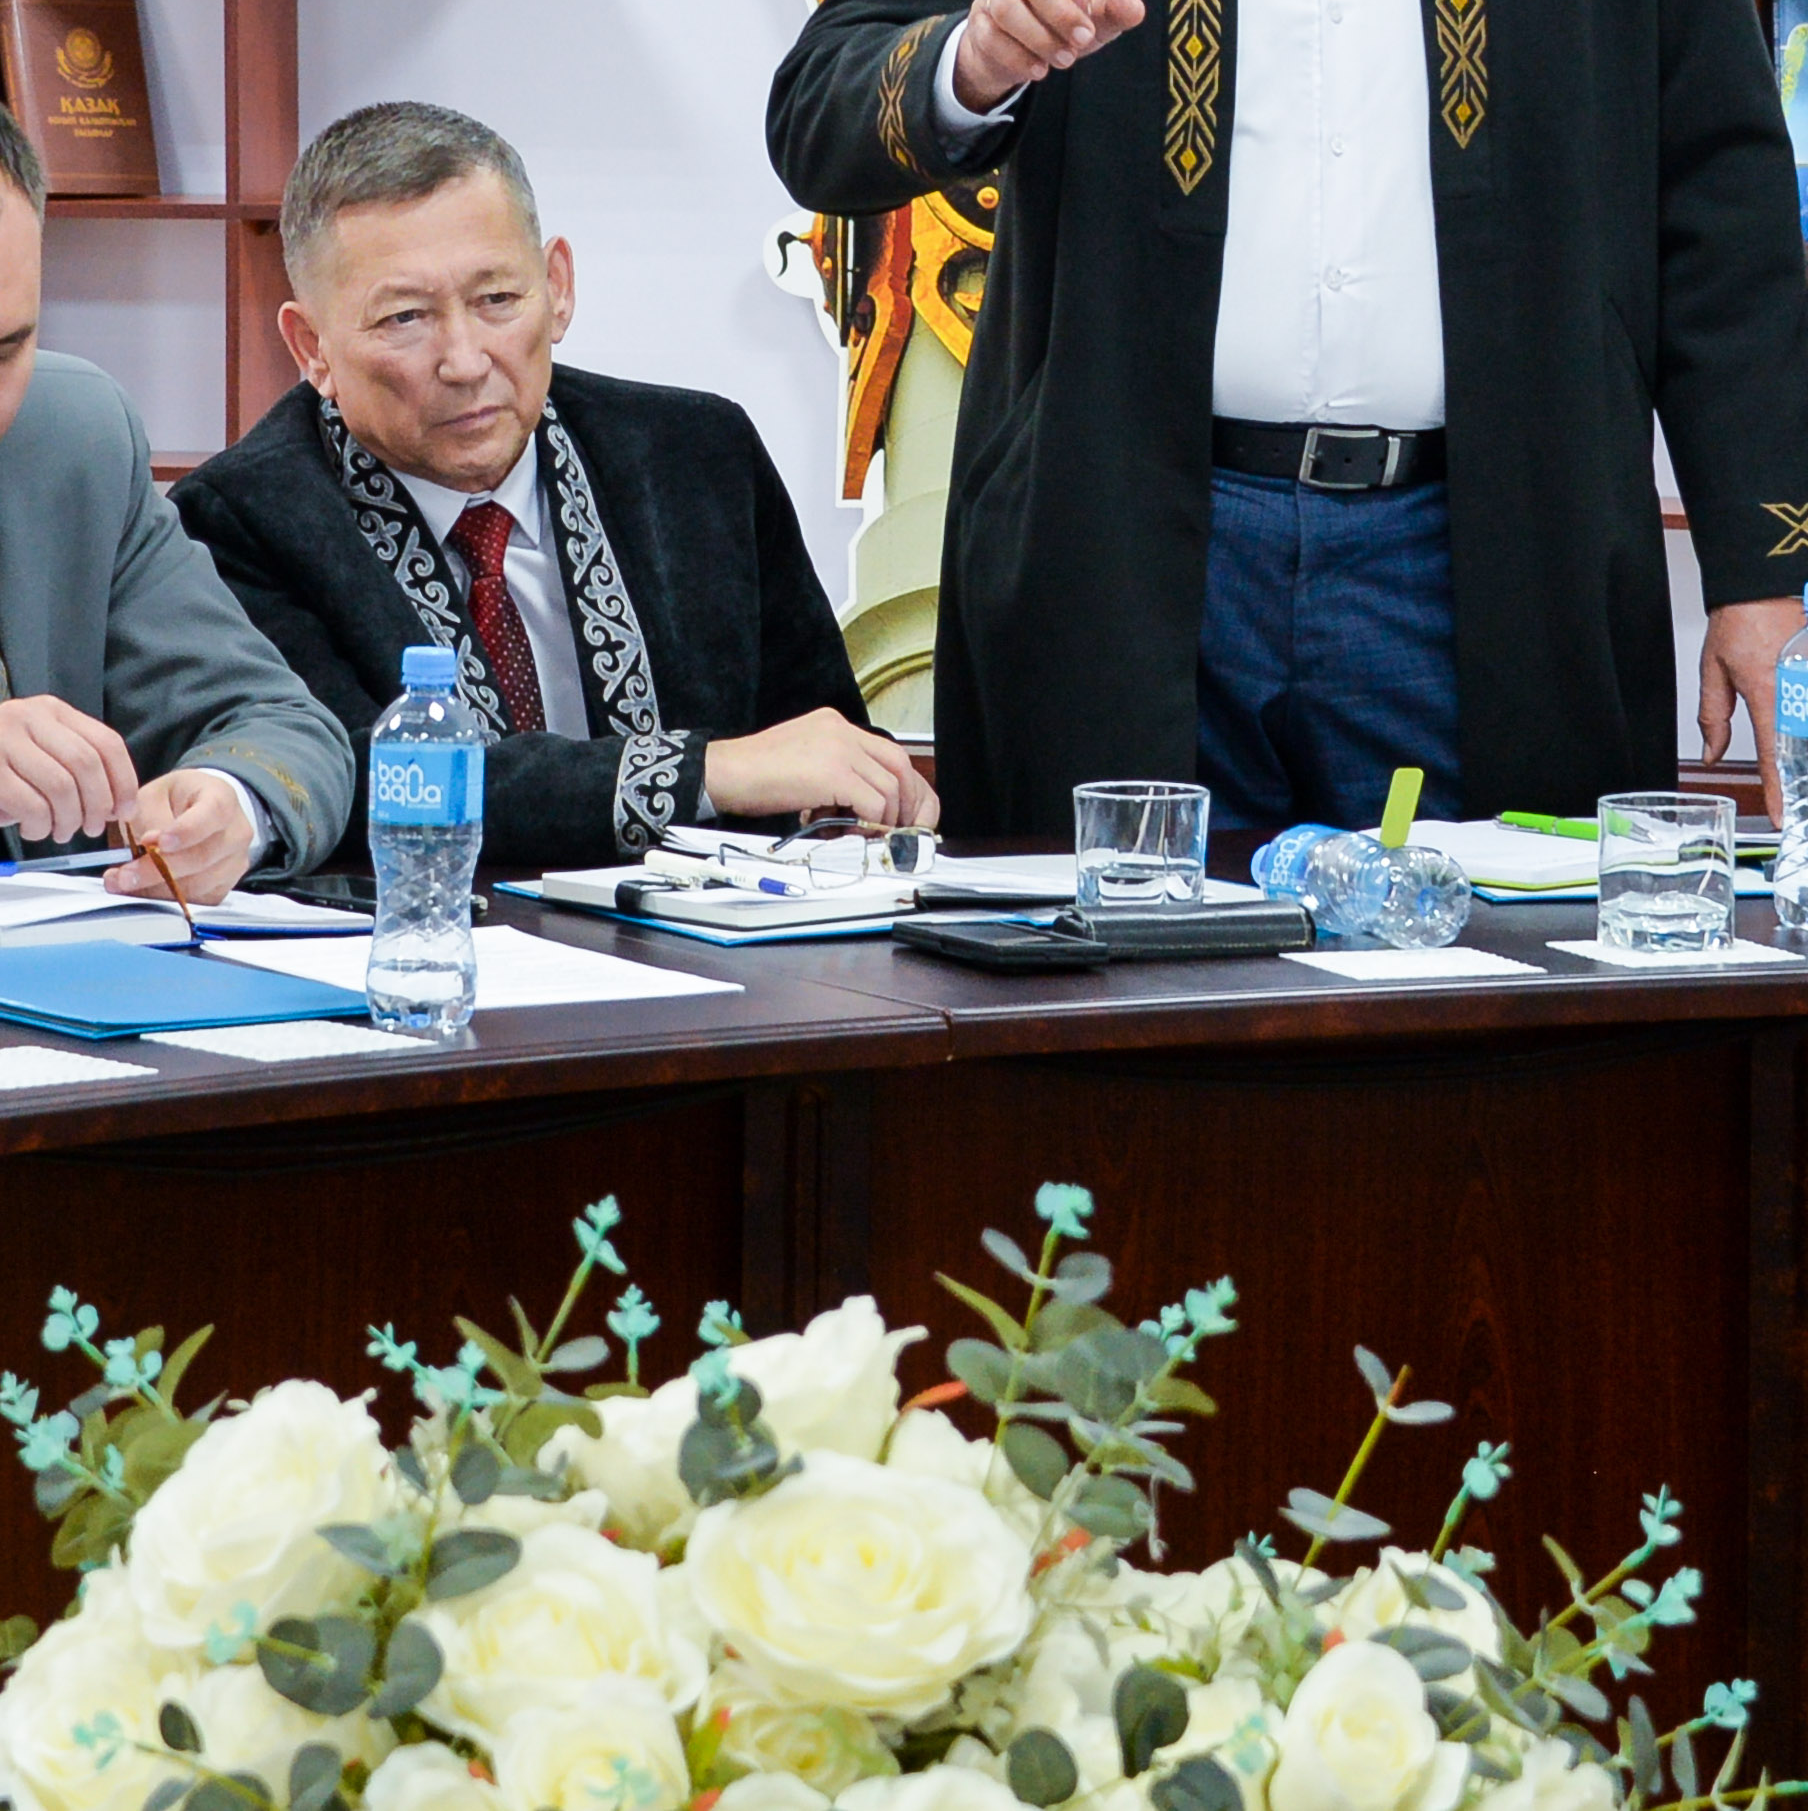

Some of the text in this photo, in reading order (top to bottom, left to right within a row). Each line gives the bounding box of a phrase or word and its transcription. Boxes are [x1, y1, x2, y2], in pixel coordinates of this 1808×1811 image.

[60, 96, 121, 116] ҚАЗАҚ
[378, 759, 424, 784] bon
[378, 782, 442, 806] aqua
